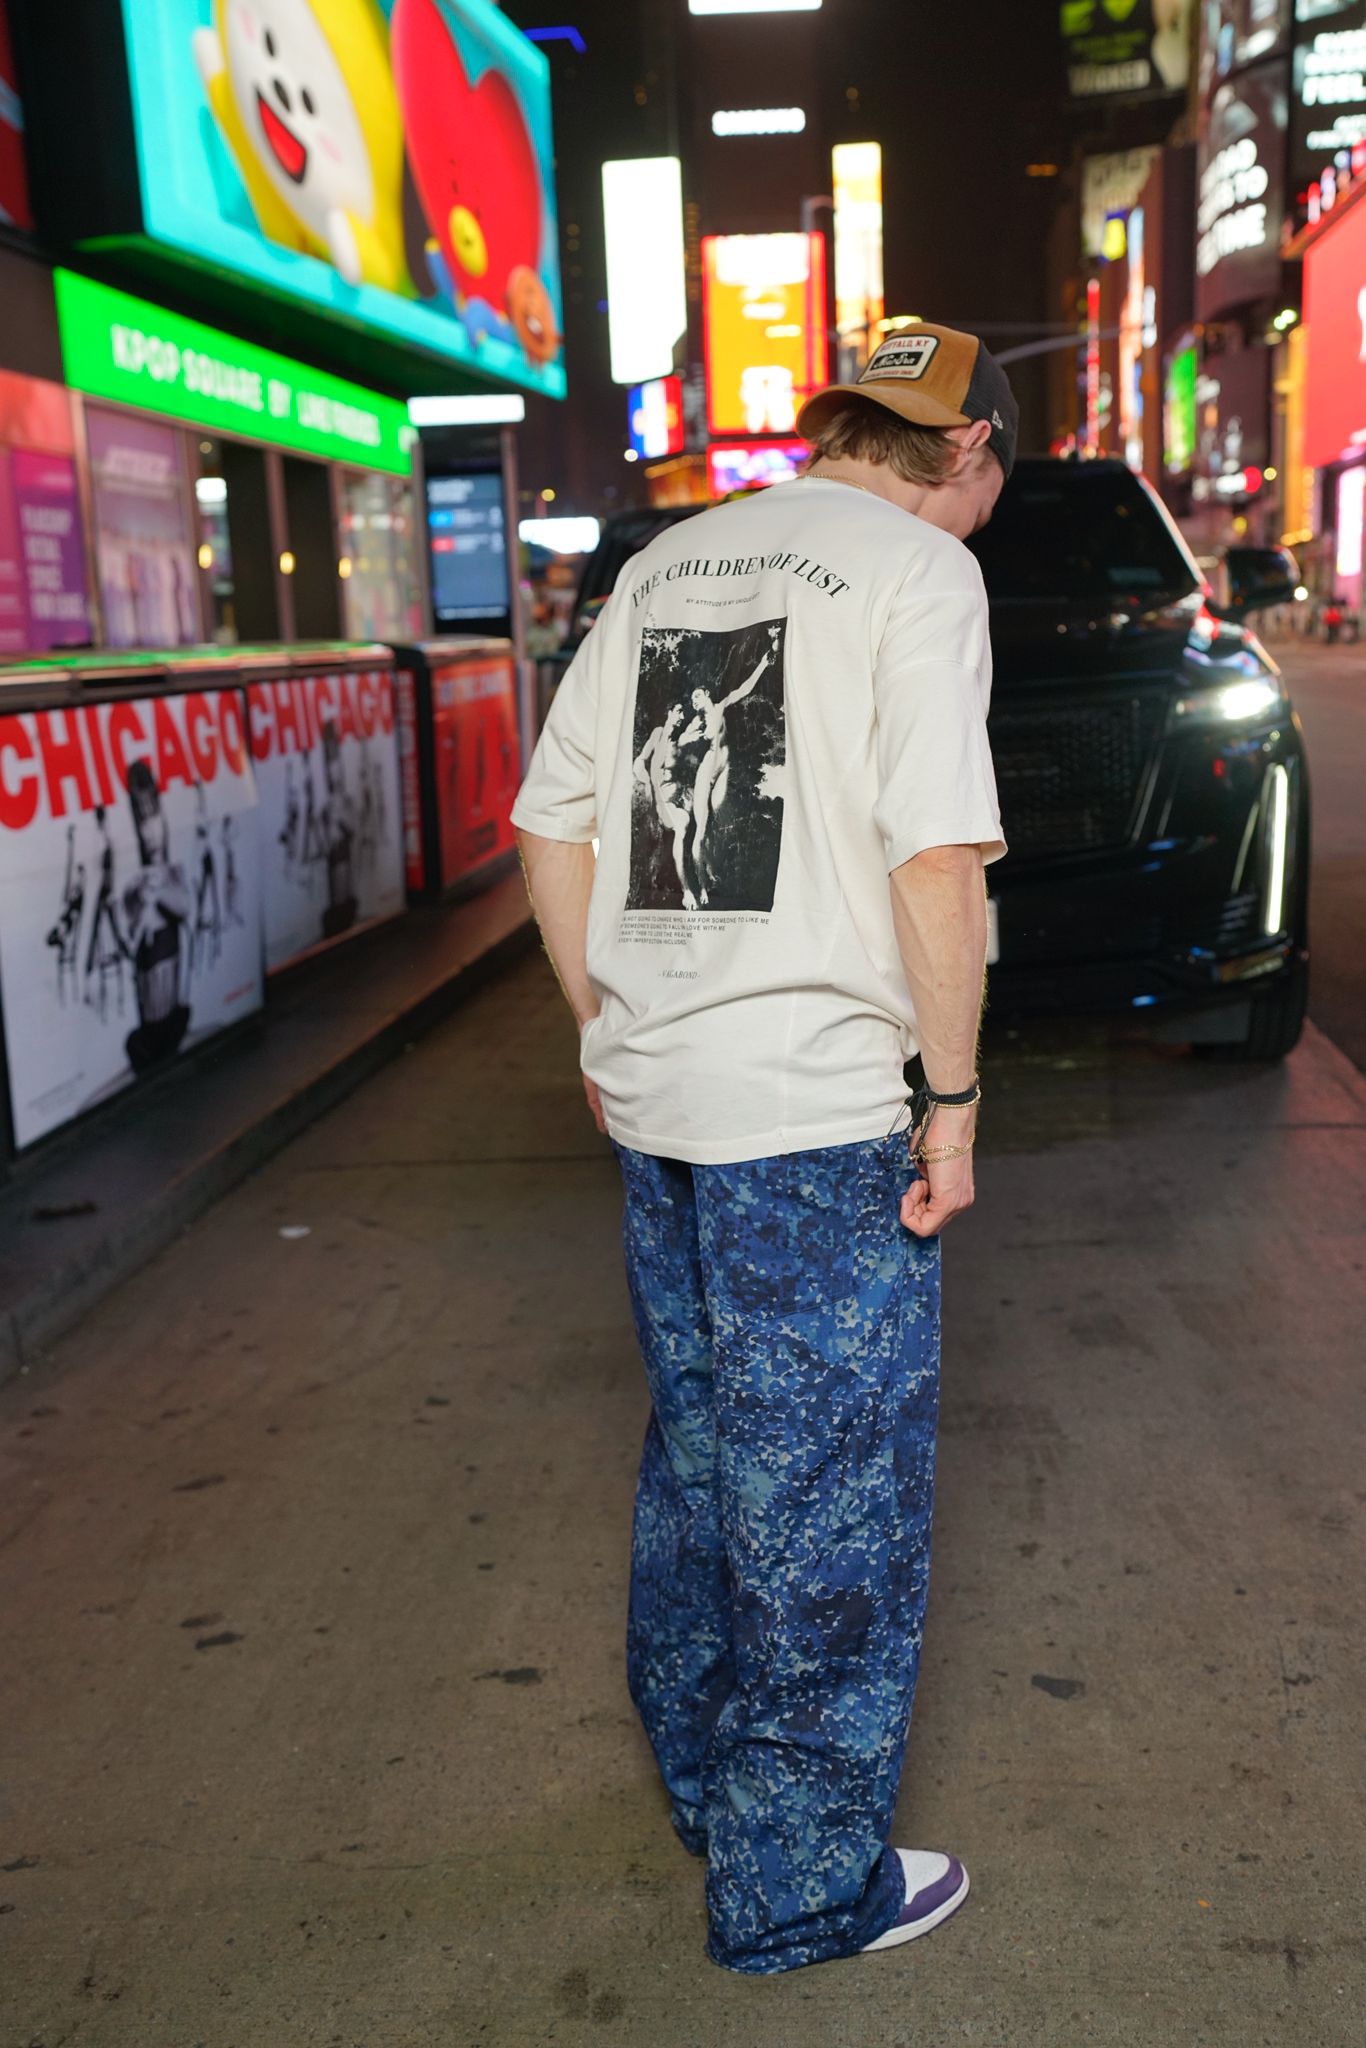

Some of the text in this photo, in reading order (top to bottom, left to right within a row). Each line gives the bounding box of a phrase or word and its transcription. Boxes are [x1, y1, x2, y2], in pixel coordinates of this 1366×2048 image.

[632, 553, 850, 608] THE CHILDREN OF LUST
[0, 689, 246, 830] CHICAGO
[248, 670, 394, 762] CHICAGO
